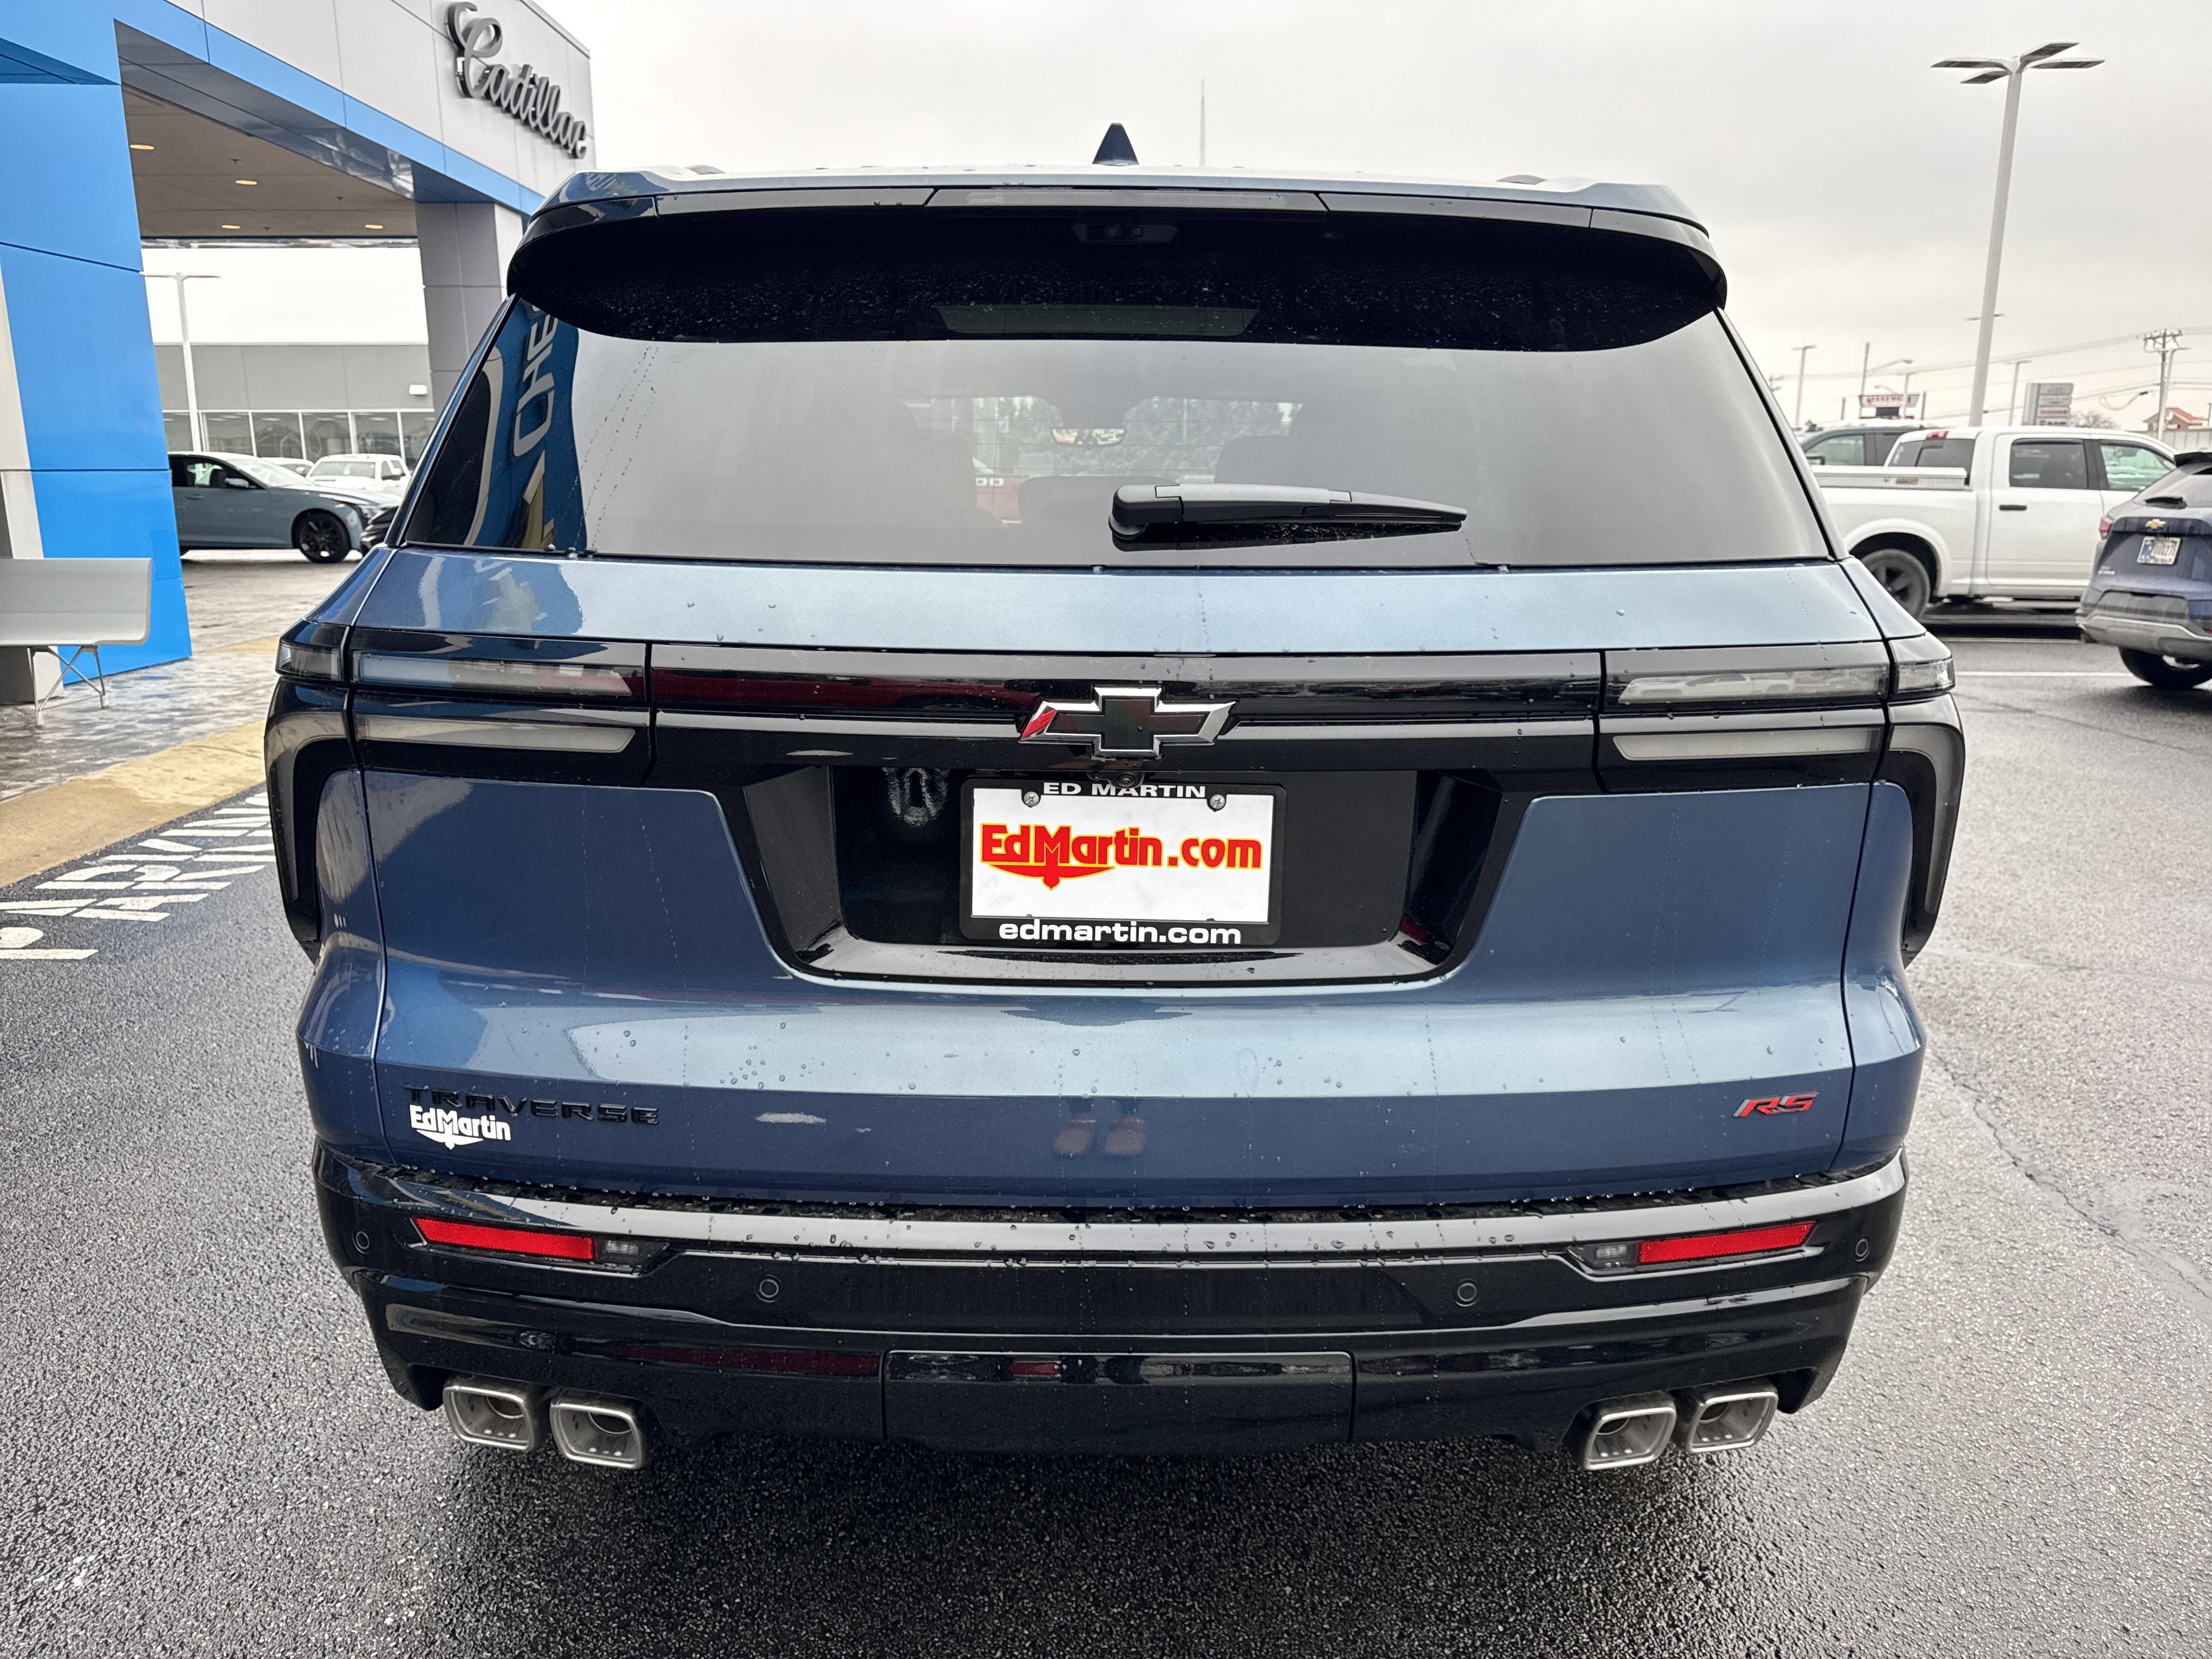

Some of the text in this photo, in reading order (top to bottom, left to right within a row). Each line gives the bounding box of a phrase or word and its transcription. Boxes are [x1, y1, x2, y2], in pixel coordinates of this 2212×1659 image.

[445, 2, 586, 159] Cadillac
[1043, 782, 1206, 798] ED MARTIN
[980, 823, 1263, 870] EdMartin.com
[999, 919, 1242, 944] edmartin.com
[403, 1084, 659, 1125] TRAVERSE
[409, 1104, 511, 1141] EdMartin
[1732, 1091, 1820, 1118] RS
